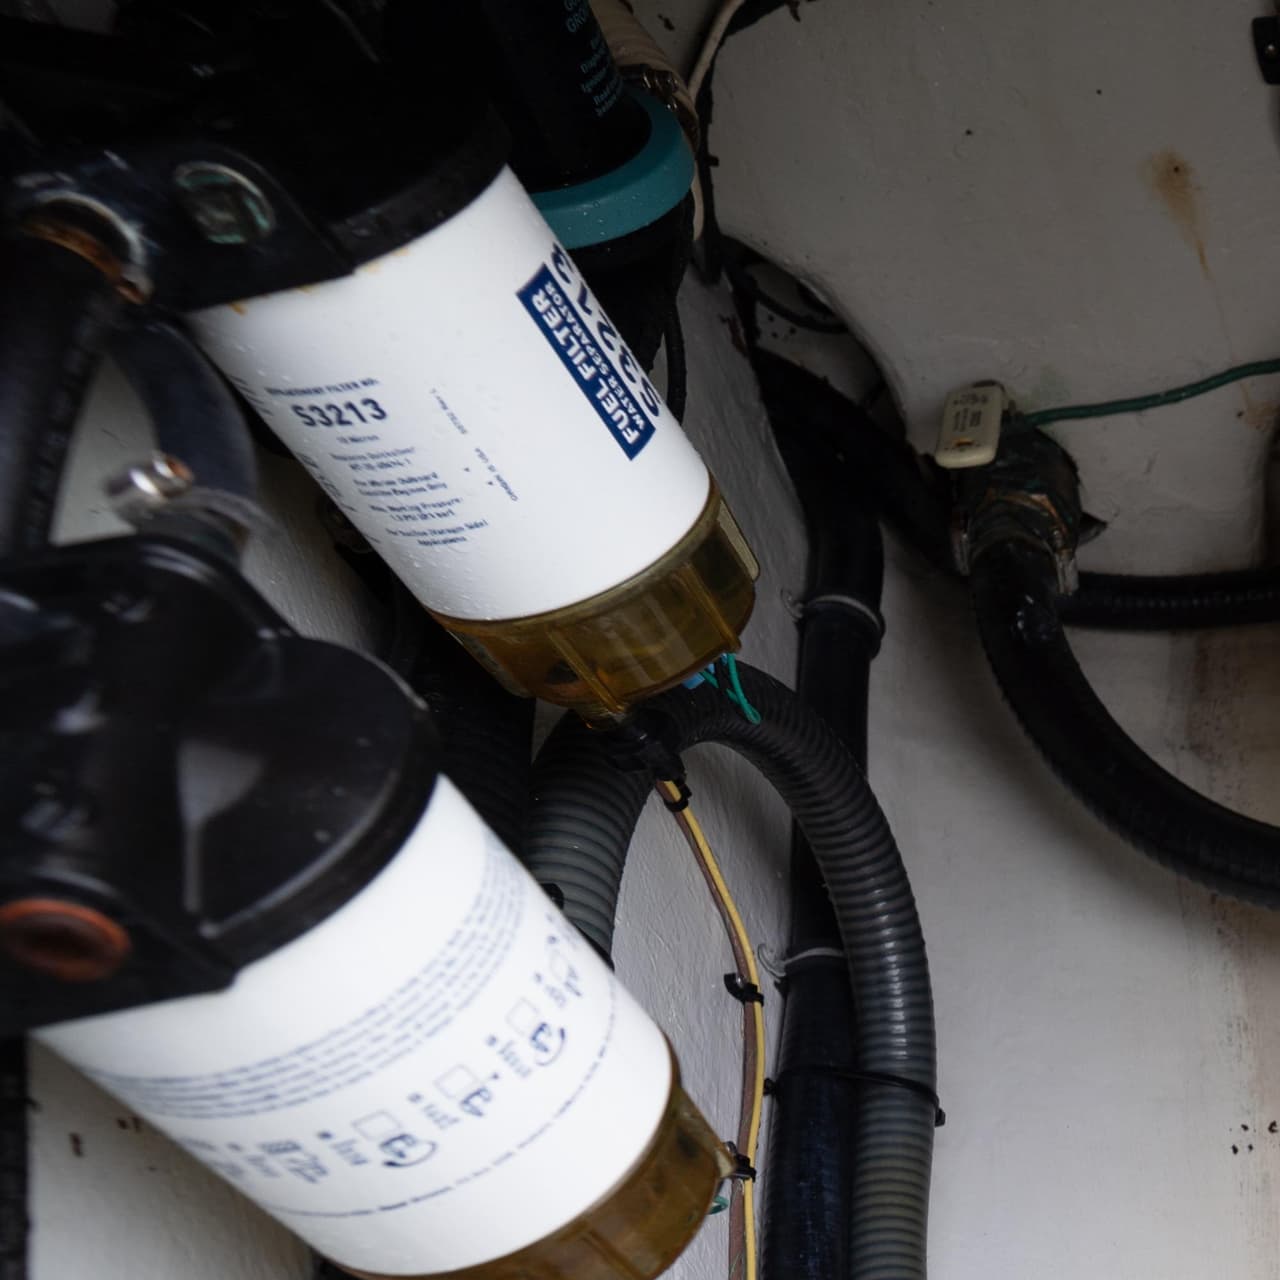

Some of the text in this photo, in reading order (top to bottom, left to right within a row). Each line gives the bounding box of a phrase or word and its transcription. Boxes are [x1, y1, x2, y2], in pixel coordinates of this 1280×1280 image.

[292, 398, 387, 427] S3213
[531, 288, 641, 445] FUEL FILTER
[544, 281, 646, 431] WATER SEPARATOR
